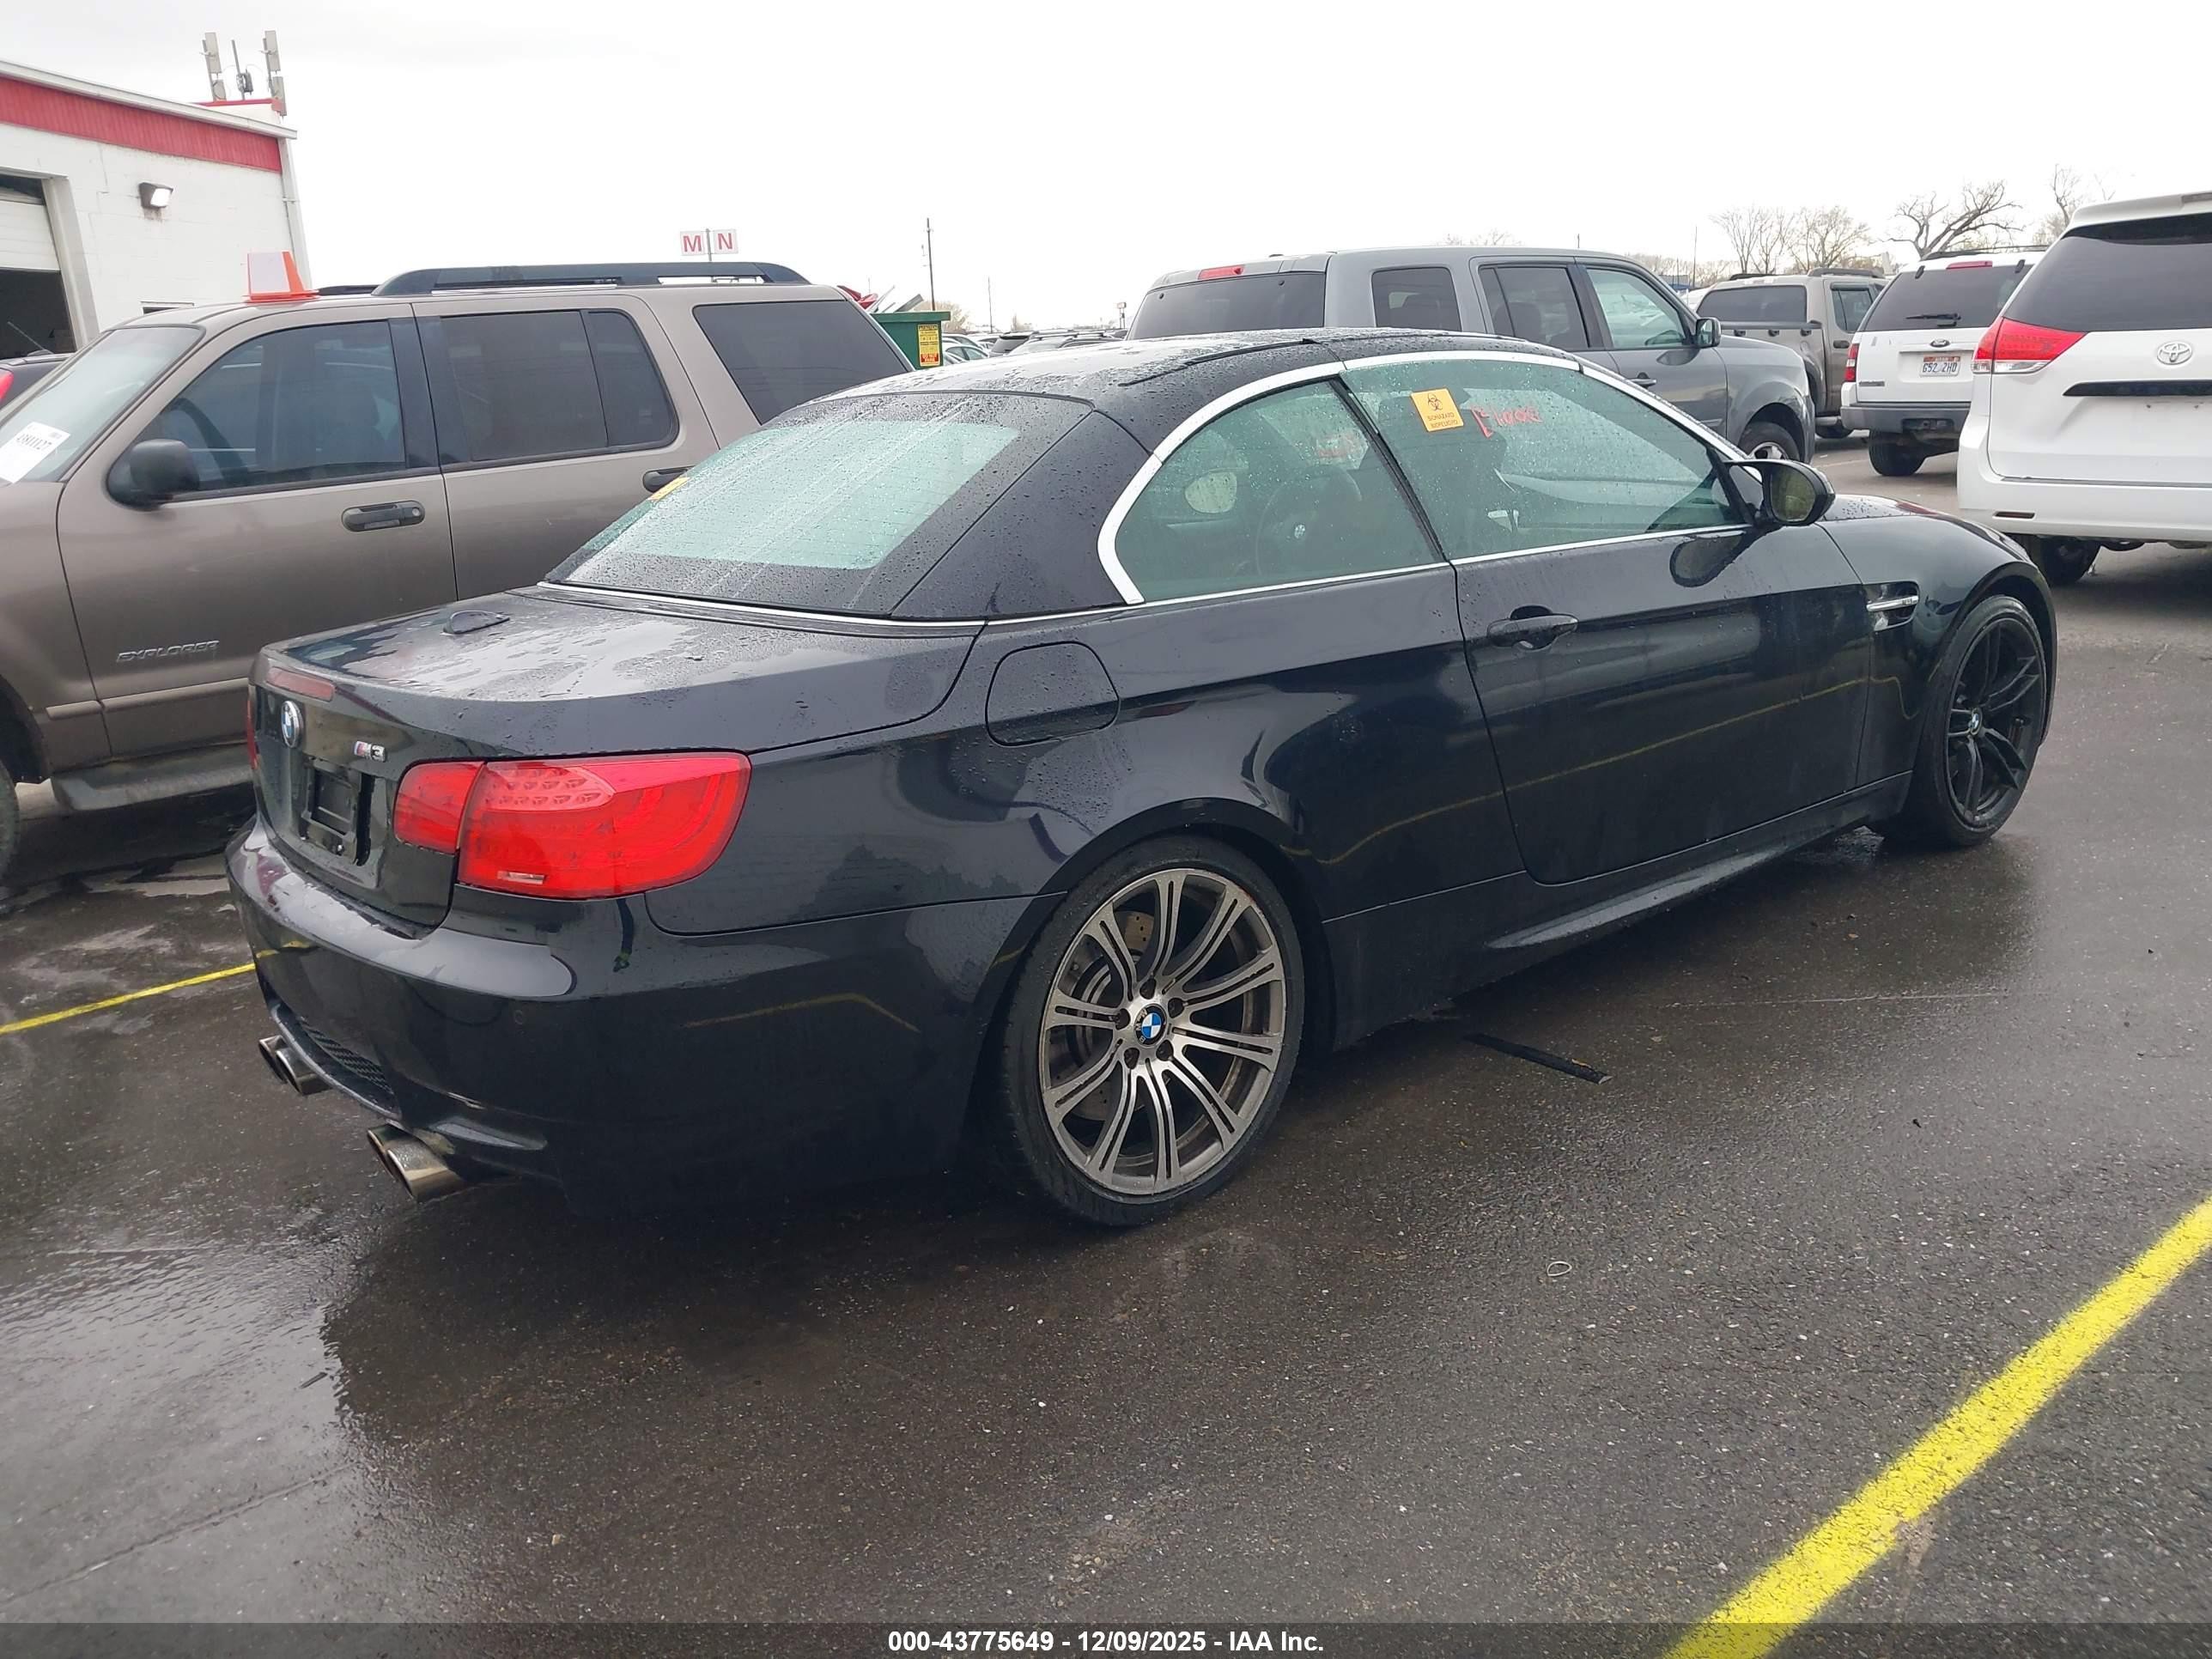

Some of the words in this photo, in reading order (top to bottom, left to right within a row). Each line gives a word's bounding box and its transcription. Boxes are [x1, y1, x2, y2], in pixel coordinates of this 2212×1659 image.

[684, 235, 702, 252] M
[718, 233, 732, 250] N
[116, 641, 220, 662] EXPLORER
